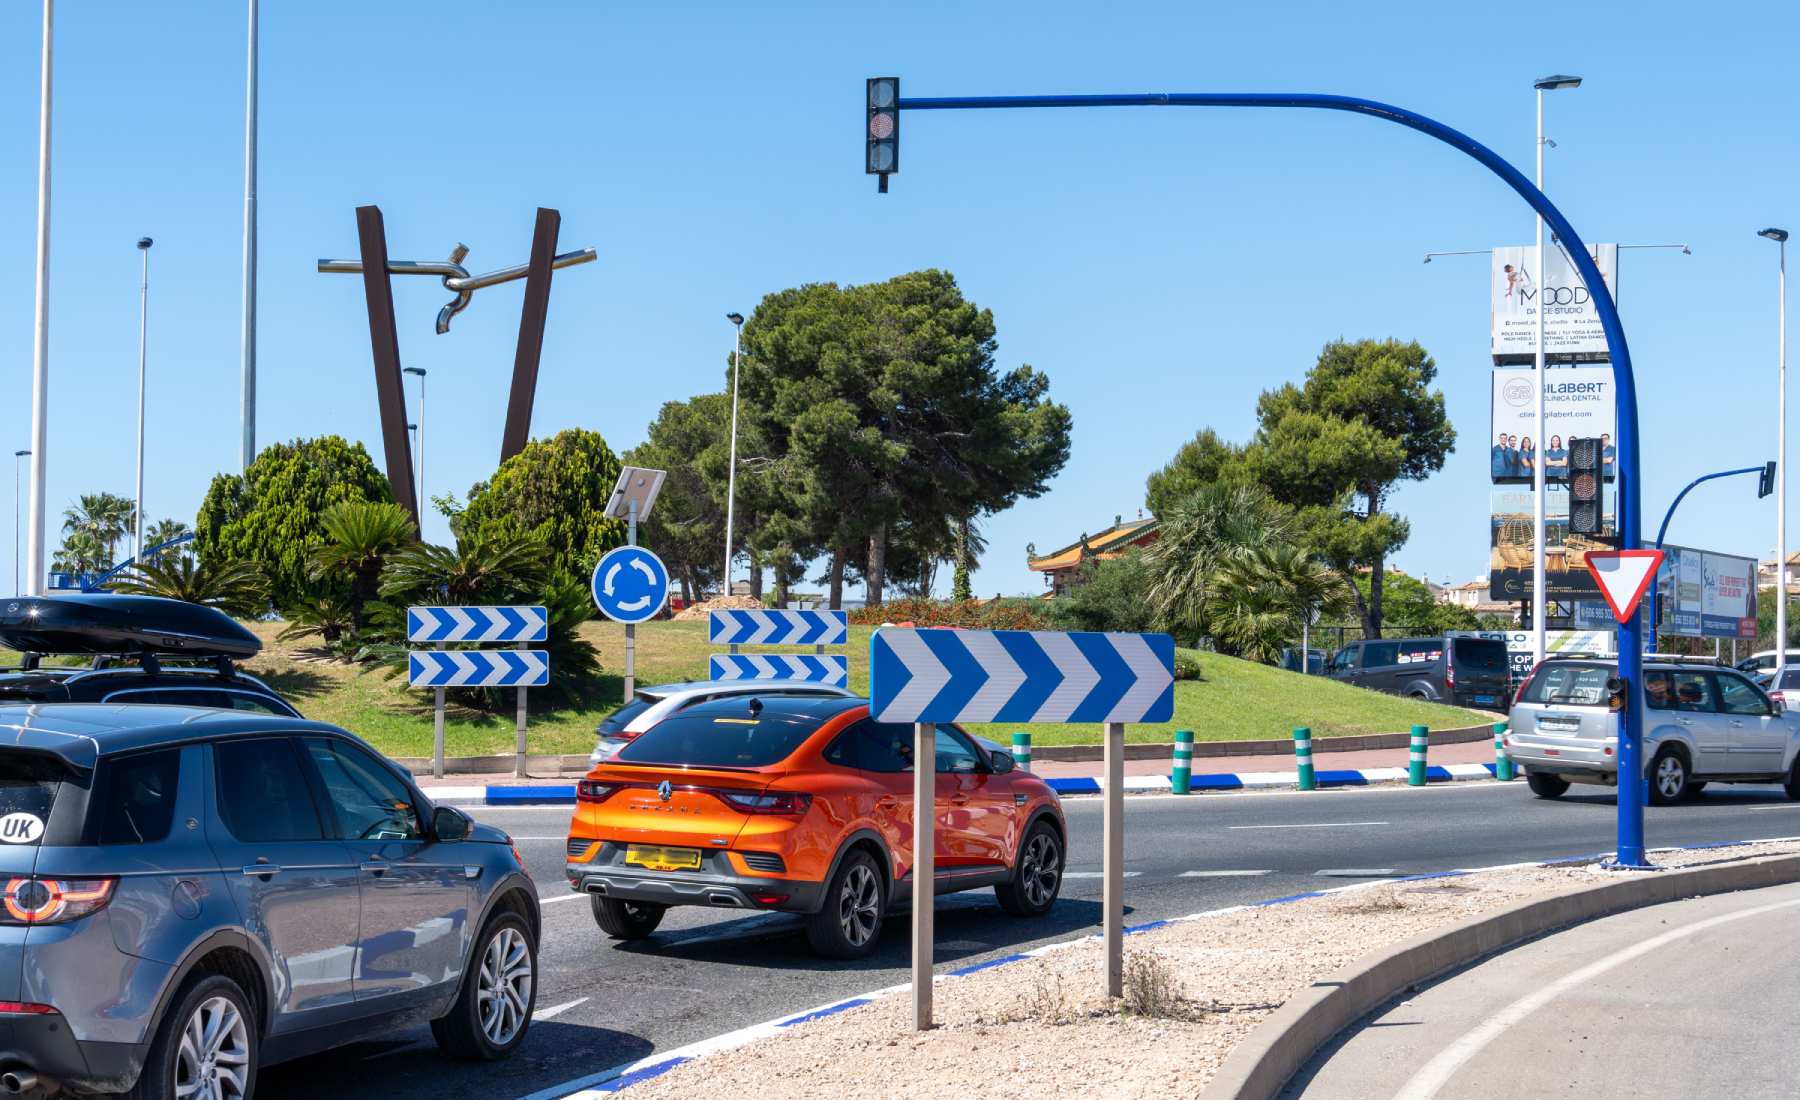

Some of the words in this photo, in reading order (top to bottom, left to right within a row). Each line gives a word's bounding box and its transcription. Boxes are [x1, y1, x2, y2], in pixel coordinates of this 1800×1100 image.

[1526, 307, 1552, 315] DACE
[1554, 306, 1583, 315] STUDIO
[1519, 410, 1592, 419] clinigilabert.com
[3, 818, 35, 839] UK
